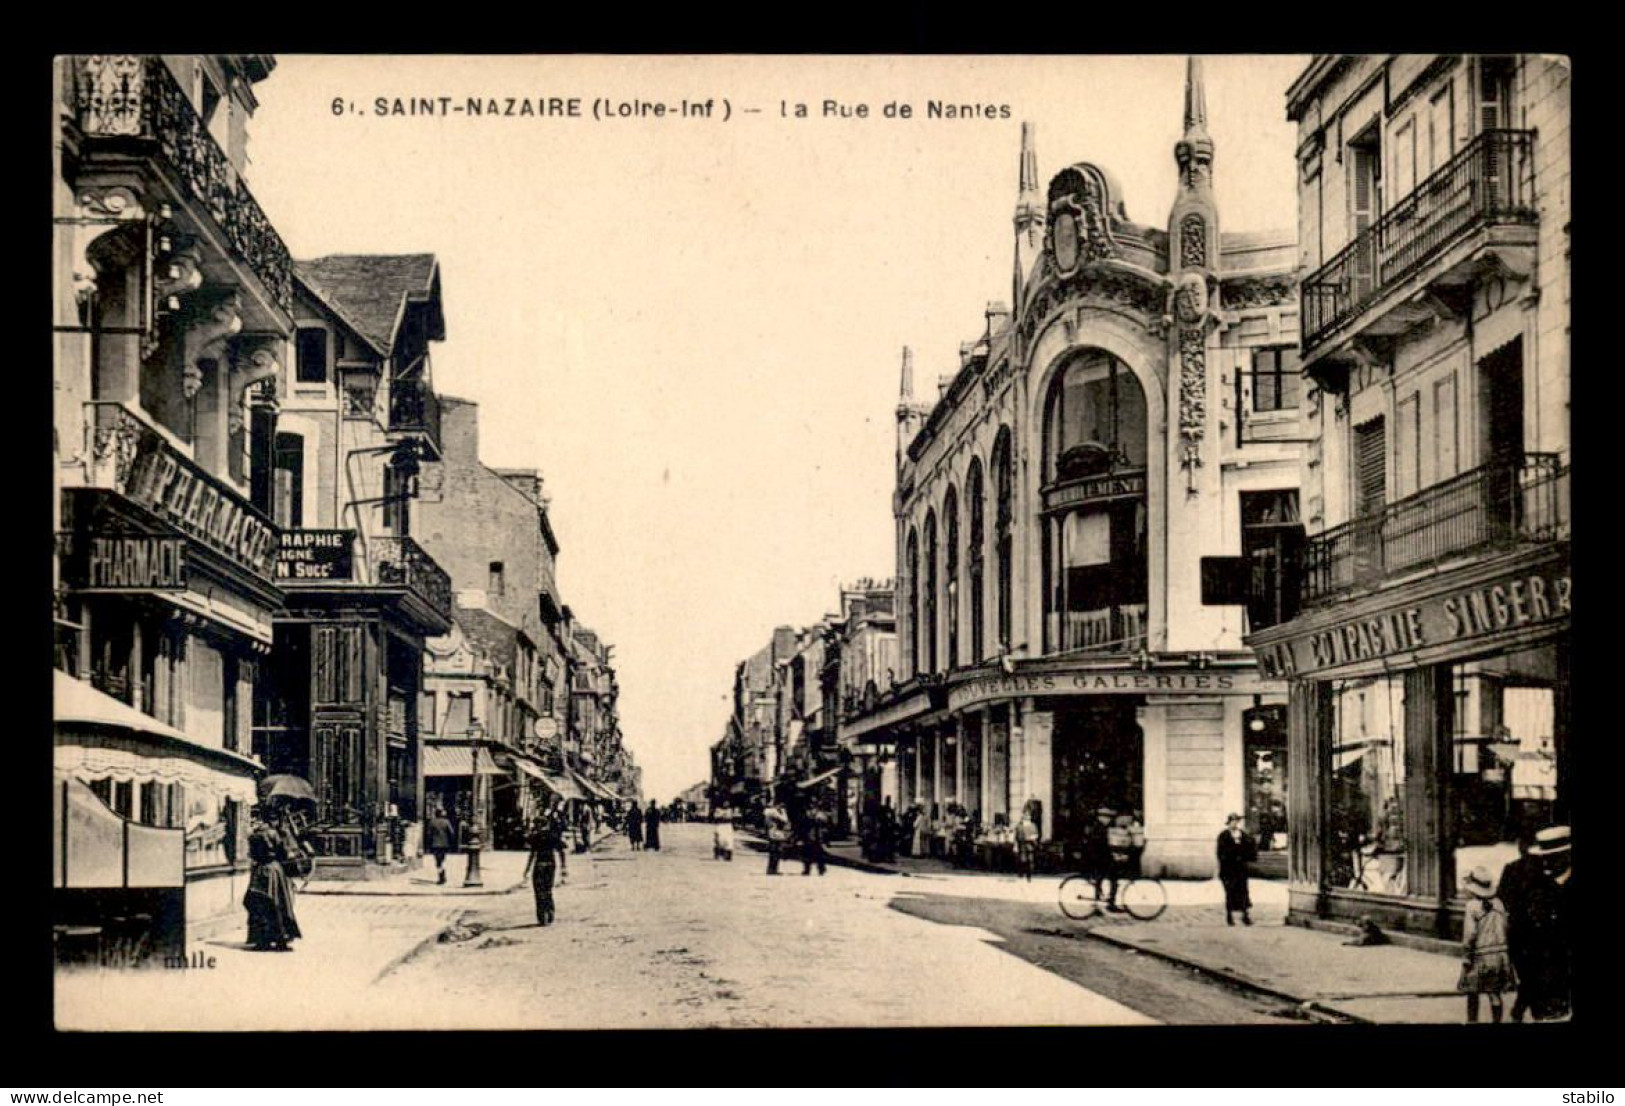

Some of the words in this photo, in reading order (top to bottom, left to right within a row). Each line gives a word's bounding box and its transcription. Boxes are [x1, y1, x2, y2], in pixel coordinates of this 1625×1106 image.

[155, 453, 272, 567] PHARMACIE
[89, 538, 186, 587] PHARMACIE
[1310, 608, 1422, 667] COMPAGNIE
[1444, 575, 1549, 637] SINGER
[1072, 675, 1233, 689] GALERIES
